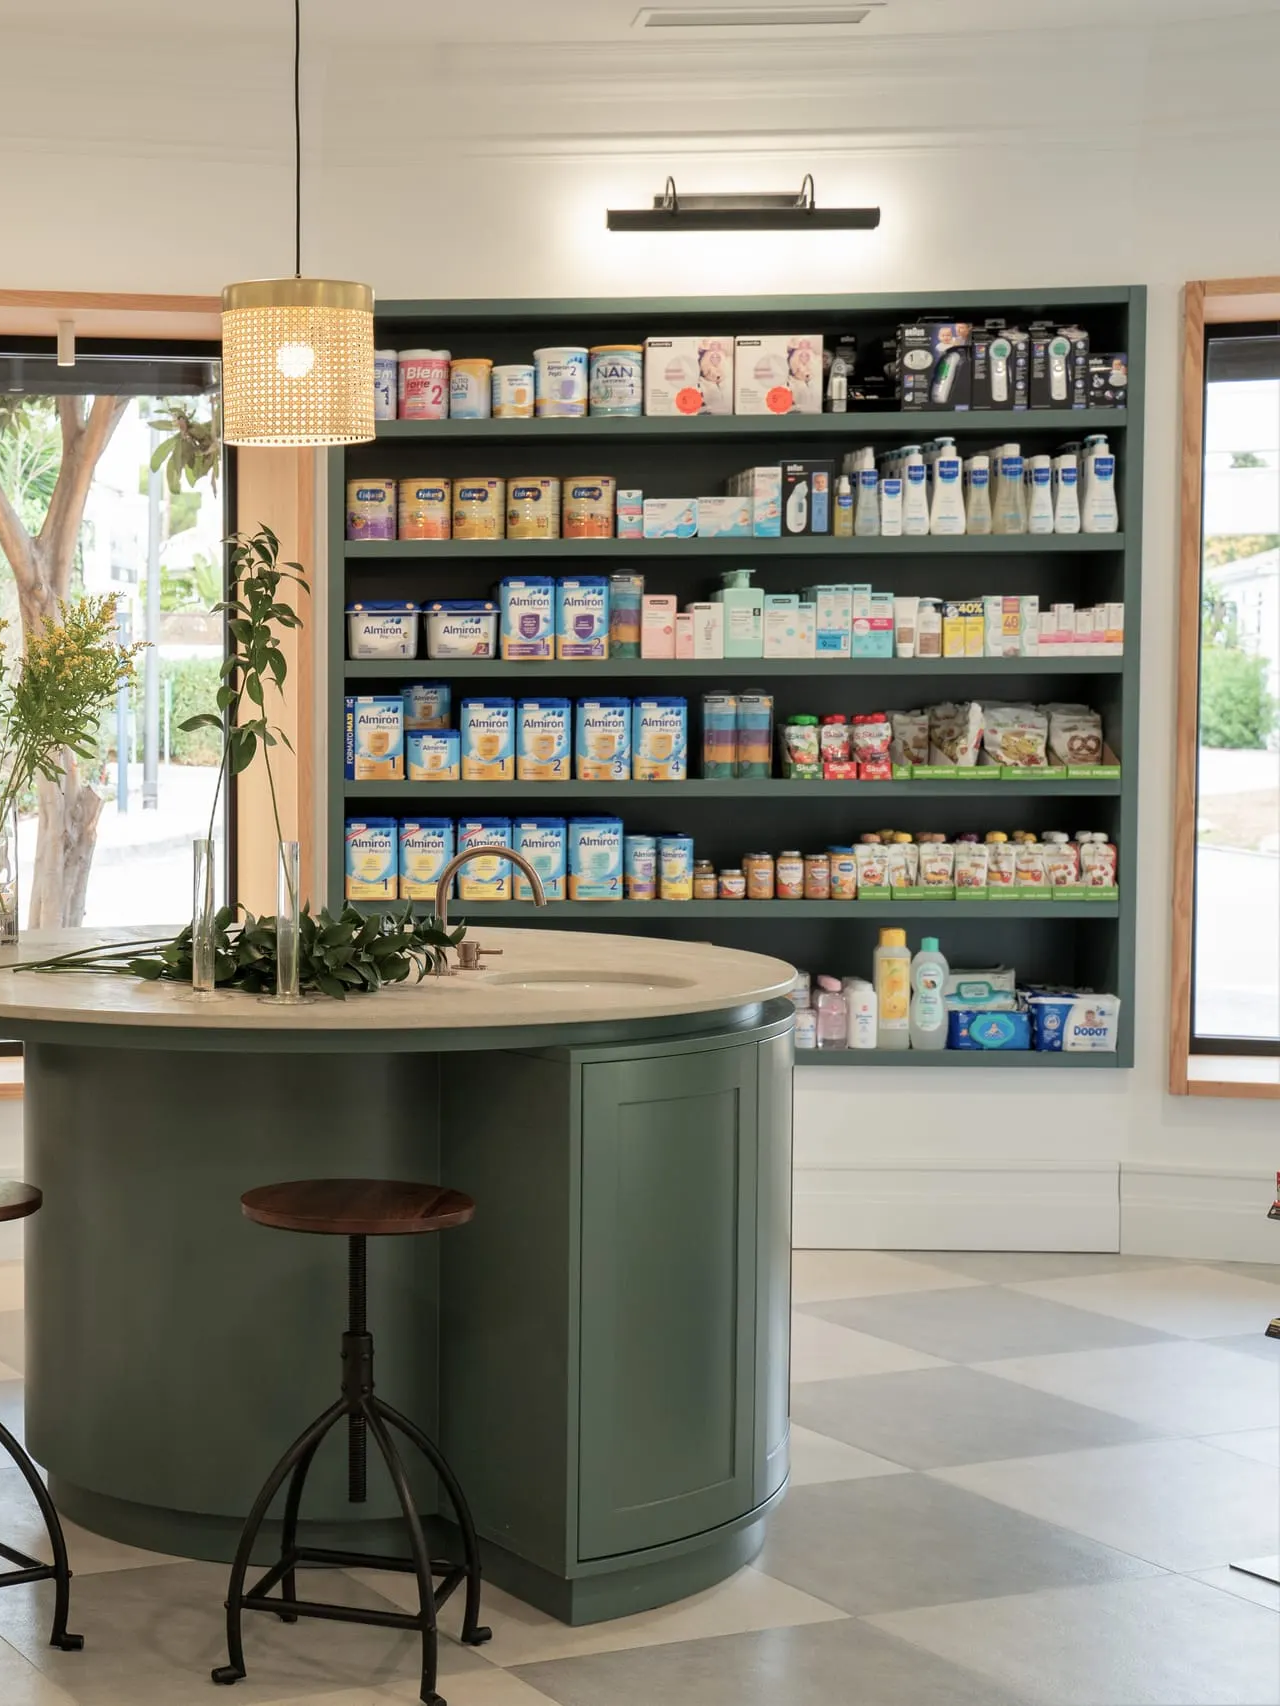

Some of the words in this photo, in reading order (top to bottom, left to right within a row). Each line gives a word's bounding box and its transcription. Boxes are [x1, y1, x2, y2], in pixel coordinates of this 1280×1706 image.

[570, 366, 576, 376] 2
[596, 367, 633, 378] NAN
[431, 385, 442, 405] 2
[959, 603, 983, 613] 40%
[400, 644, 406, 654] 1
[478, 644, 487, 654] 2
[540, 638, 546, 649] 1
[593, 638, 601, 649] 2
[389, 757, 396, 769] 1
[499, 759, 505, 771] 1
[553, 759, 561, 772] 2
[614, 761, 623, 773] 3
[672, 761, 680, 773] 4
[383, 878, 388, 891] 1
[496, 879, 504, 891] 2
[552, 879, 558, 891] 1
[610, 878, 618, 890] 2
[1073, 1026, 1108, 1036] DODOT
